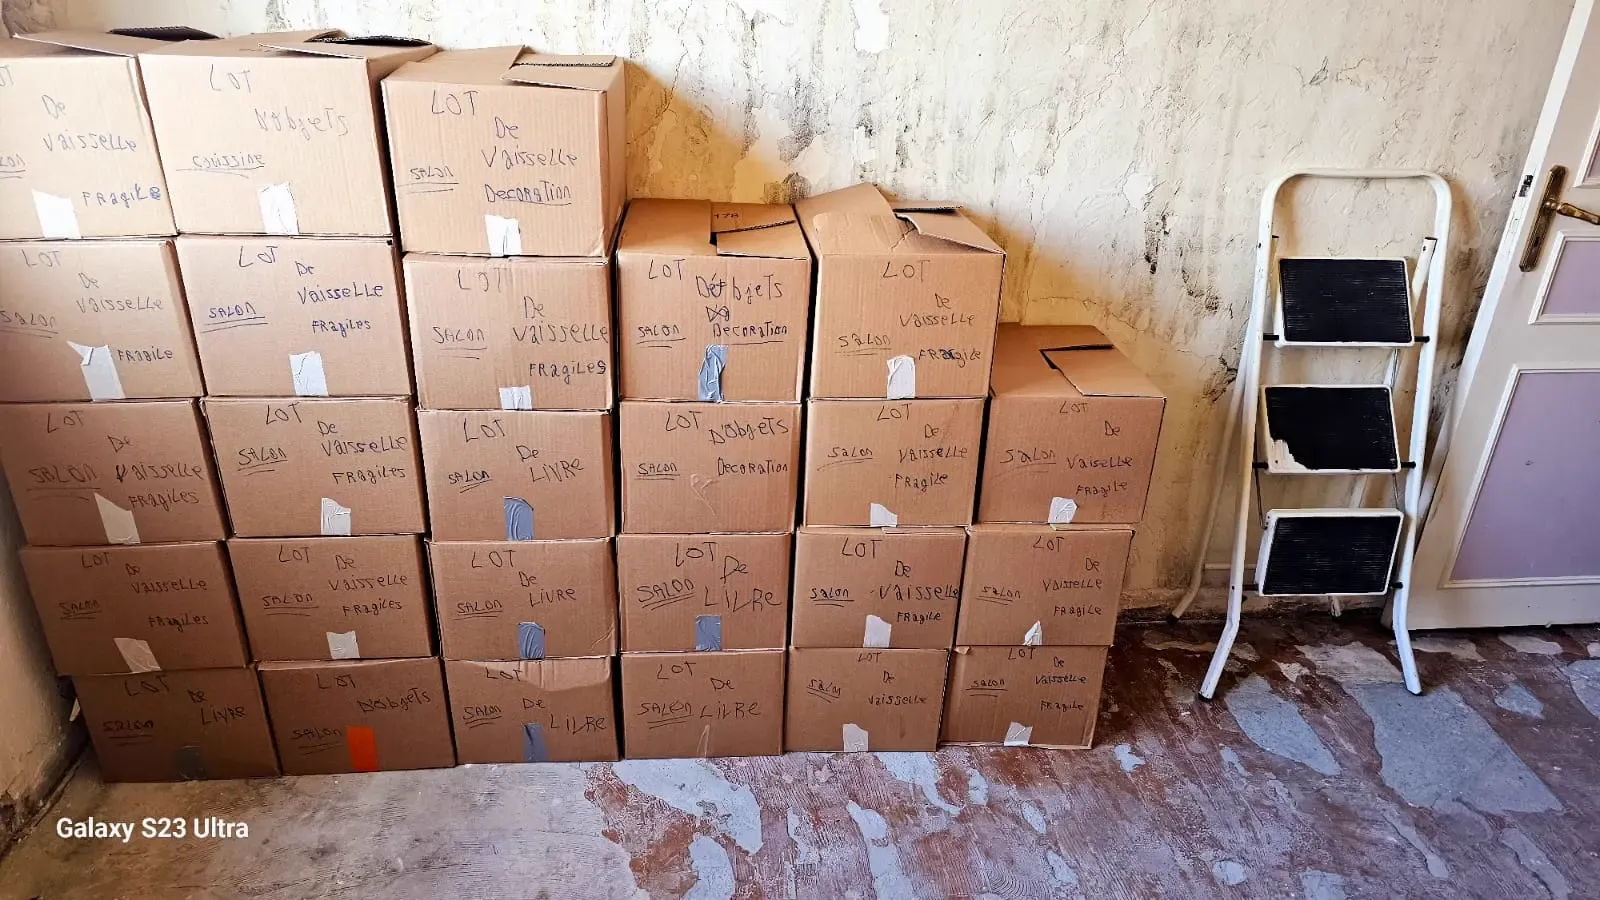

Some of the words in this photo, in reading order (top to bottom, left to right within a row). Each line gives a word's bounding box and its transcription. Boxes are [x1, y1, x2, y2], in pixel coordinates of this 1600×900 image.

[209, 64, 252, 93] LOT
[431, 89, 479, 116] LOT
[494, 116, 519, 139] De
[21, 249, 62, 268] LOT
[238, 245, 279, 268] LOT
[648, 258, 686, 280] LOT
[882, 260, 931, 283] LOT
[457, 267, 508, 293] LOT
[523, 295, 545, 319] De
[265, 401, 302, 425] LOT
[876, 403, 913, 422] LOT
[1059, 400, 1089, 414] LOT
[46, 410, 85, 434] LOT
[317, 420, 338, 436] De
[463, 417, 506, 443] LOT
[665, 410, 703, 432] LOT
[1104, 420, 1121, 437] De
[515, 444, 540, 463] De
[841, 537, 883, 559] LOT
[1032, 535, 1065, 552] LOT
[81, 552, 113, 568] LOT
[278, 544, 310, 564] LOT
[335, 554, 356, 571] De
[471, 550, 517, 569] LOT
[675, 541, 718, 567] LOT
[719, 555, 749, 584] De
[895, 559, 912, 578] De
[518, 571, 537, 588] De
[857, 651, 883, 663] LOT
[1008, 648, 1036, 660] LOT
[485, 667, 523, 682] LOT
[657, 661, 697, 680] LOT
[316, 673, 356, 690] LOT
[710, 677, 735, 691] De
[522, 697, 546, 710] De
